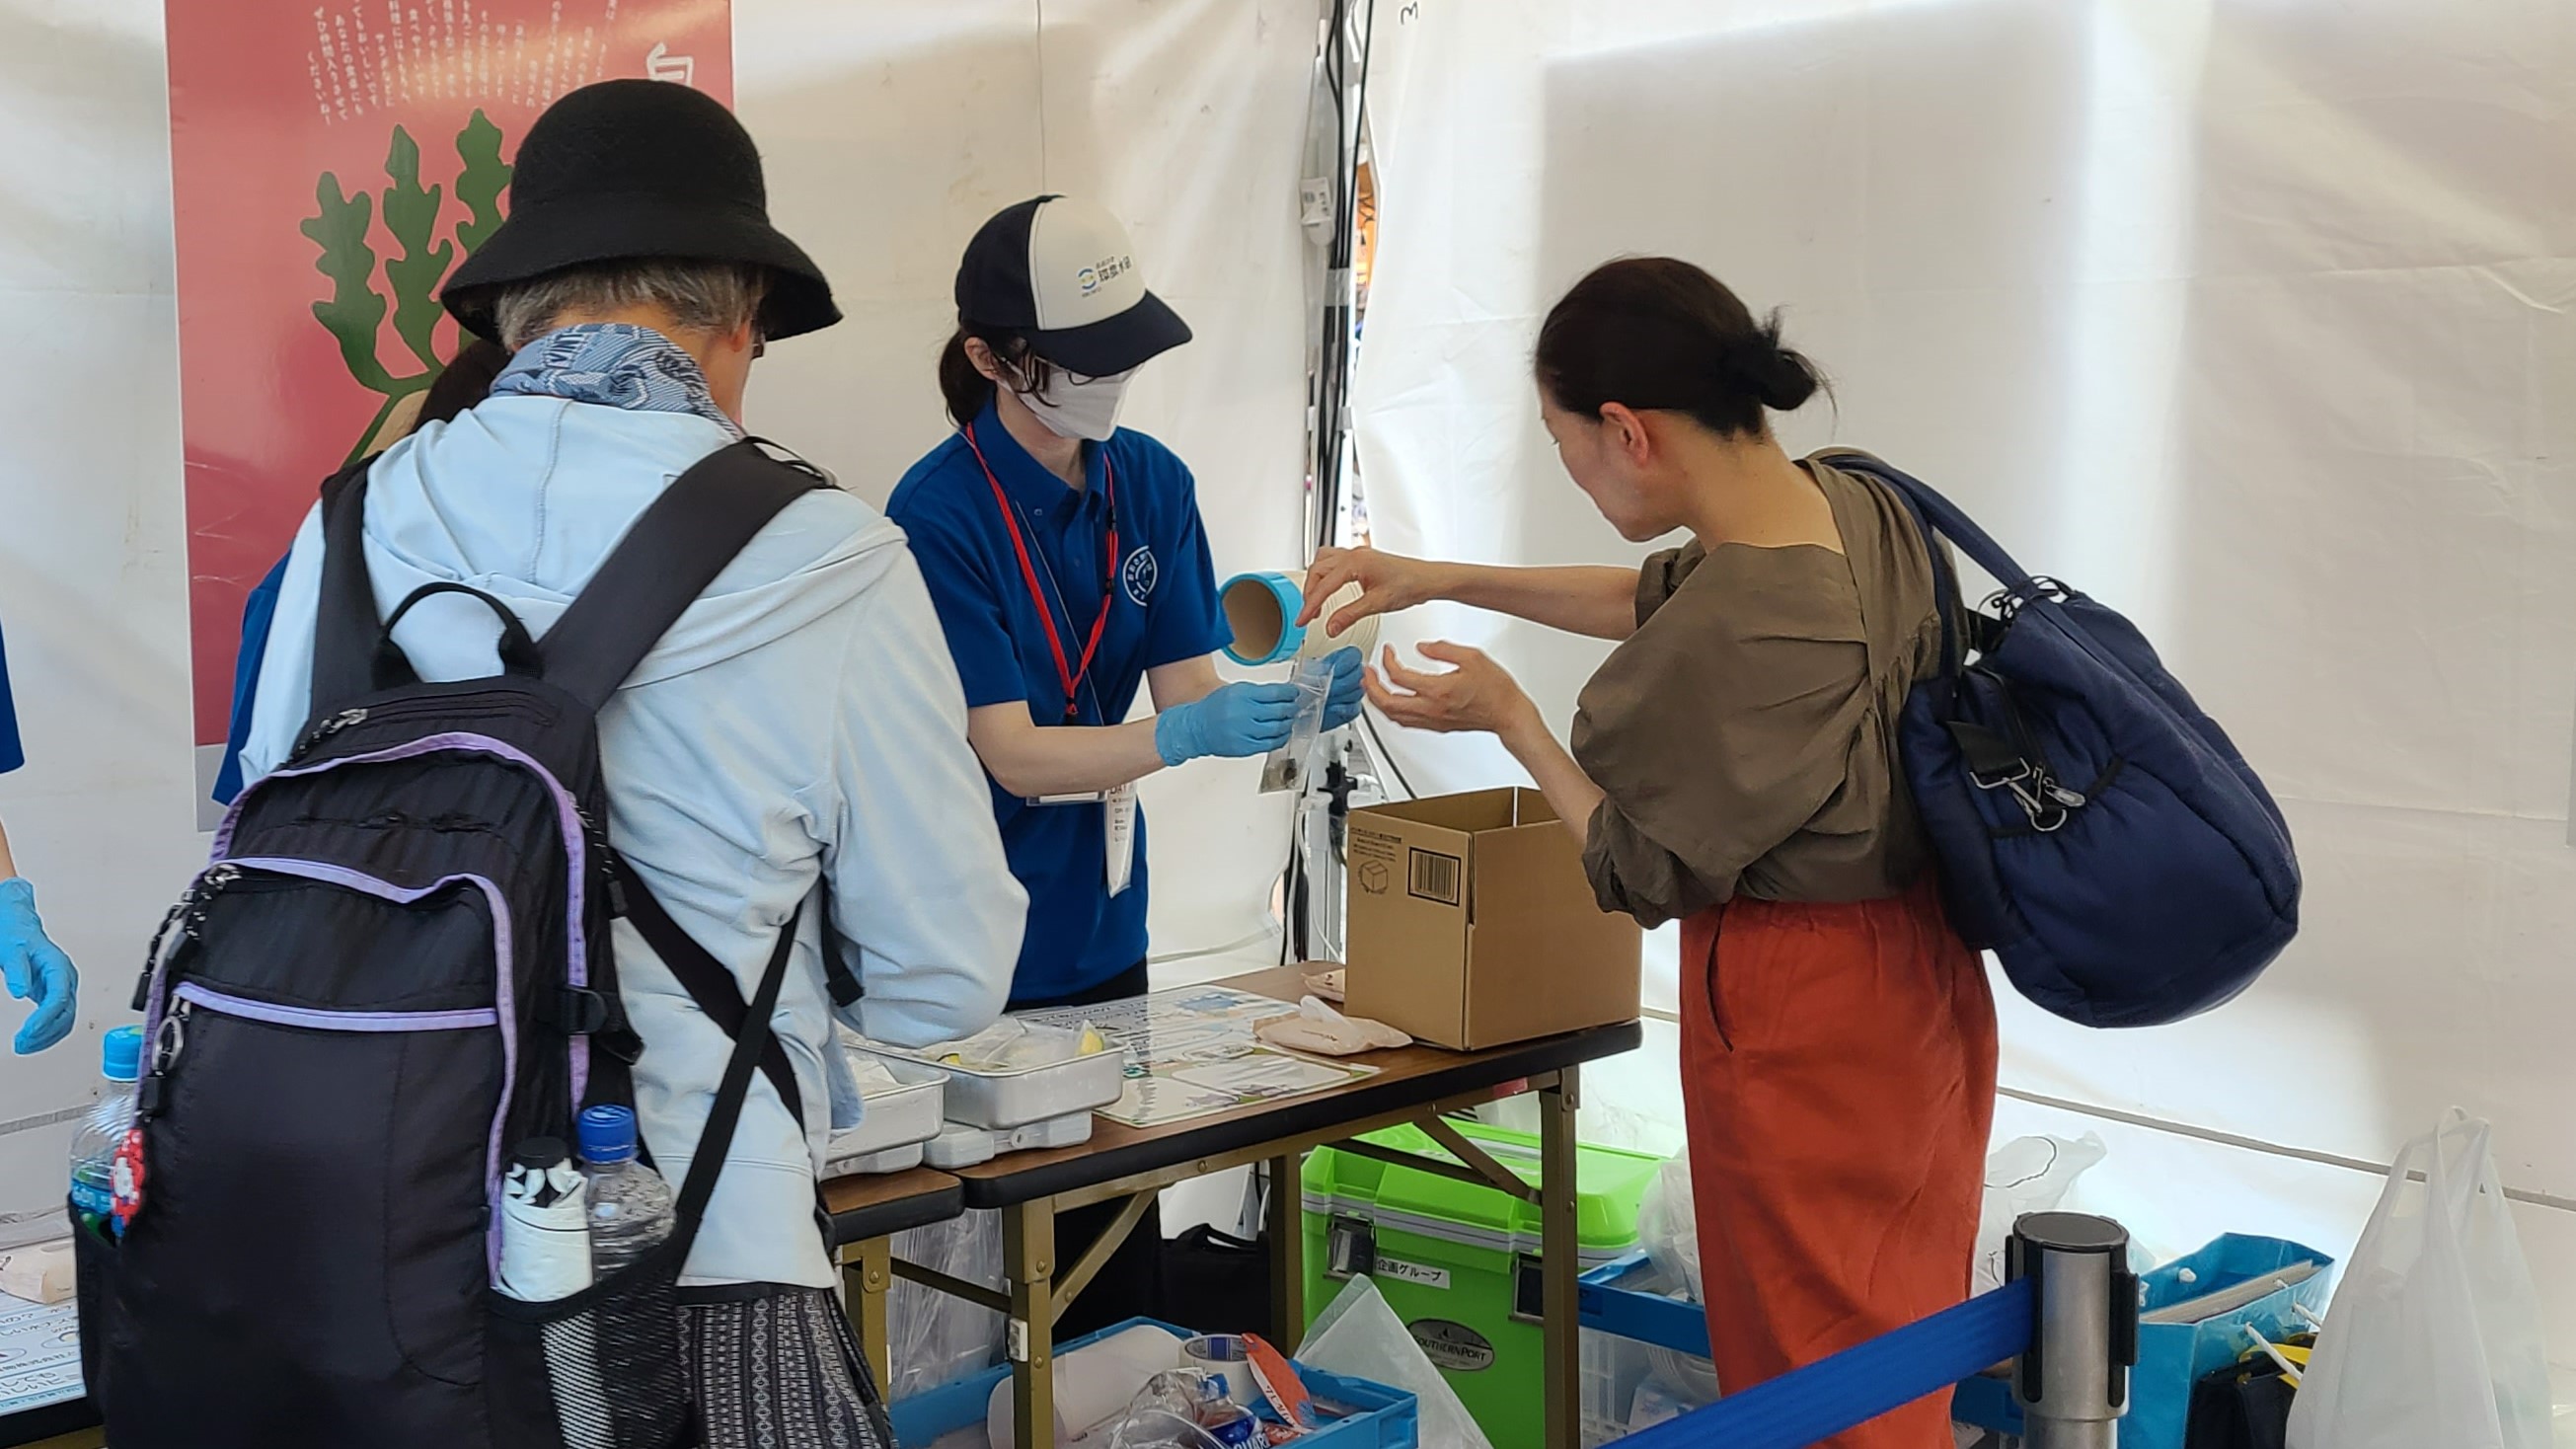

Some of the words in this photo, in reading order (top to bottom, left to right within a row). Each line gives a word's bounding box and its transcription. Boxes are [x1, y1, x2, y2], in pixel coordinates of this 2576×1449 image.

[1378, 1258, 1442, 1281] 企画グループ
